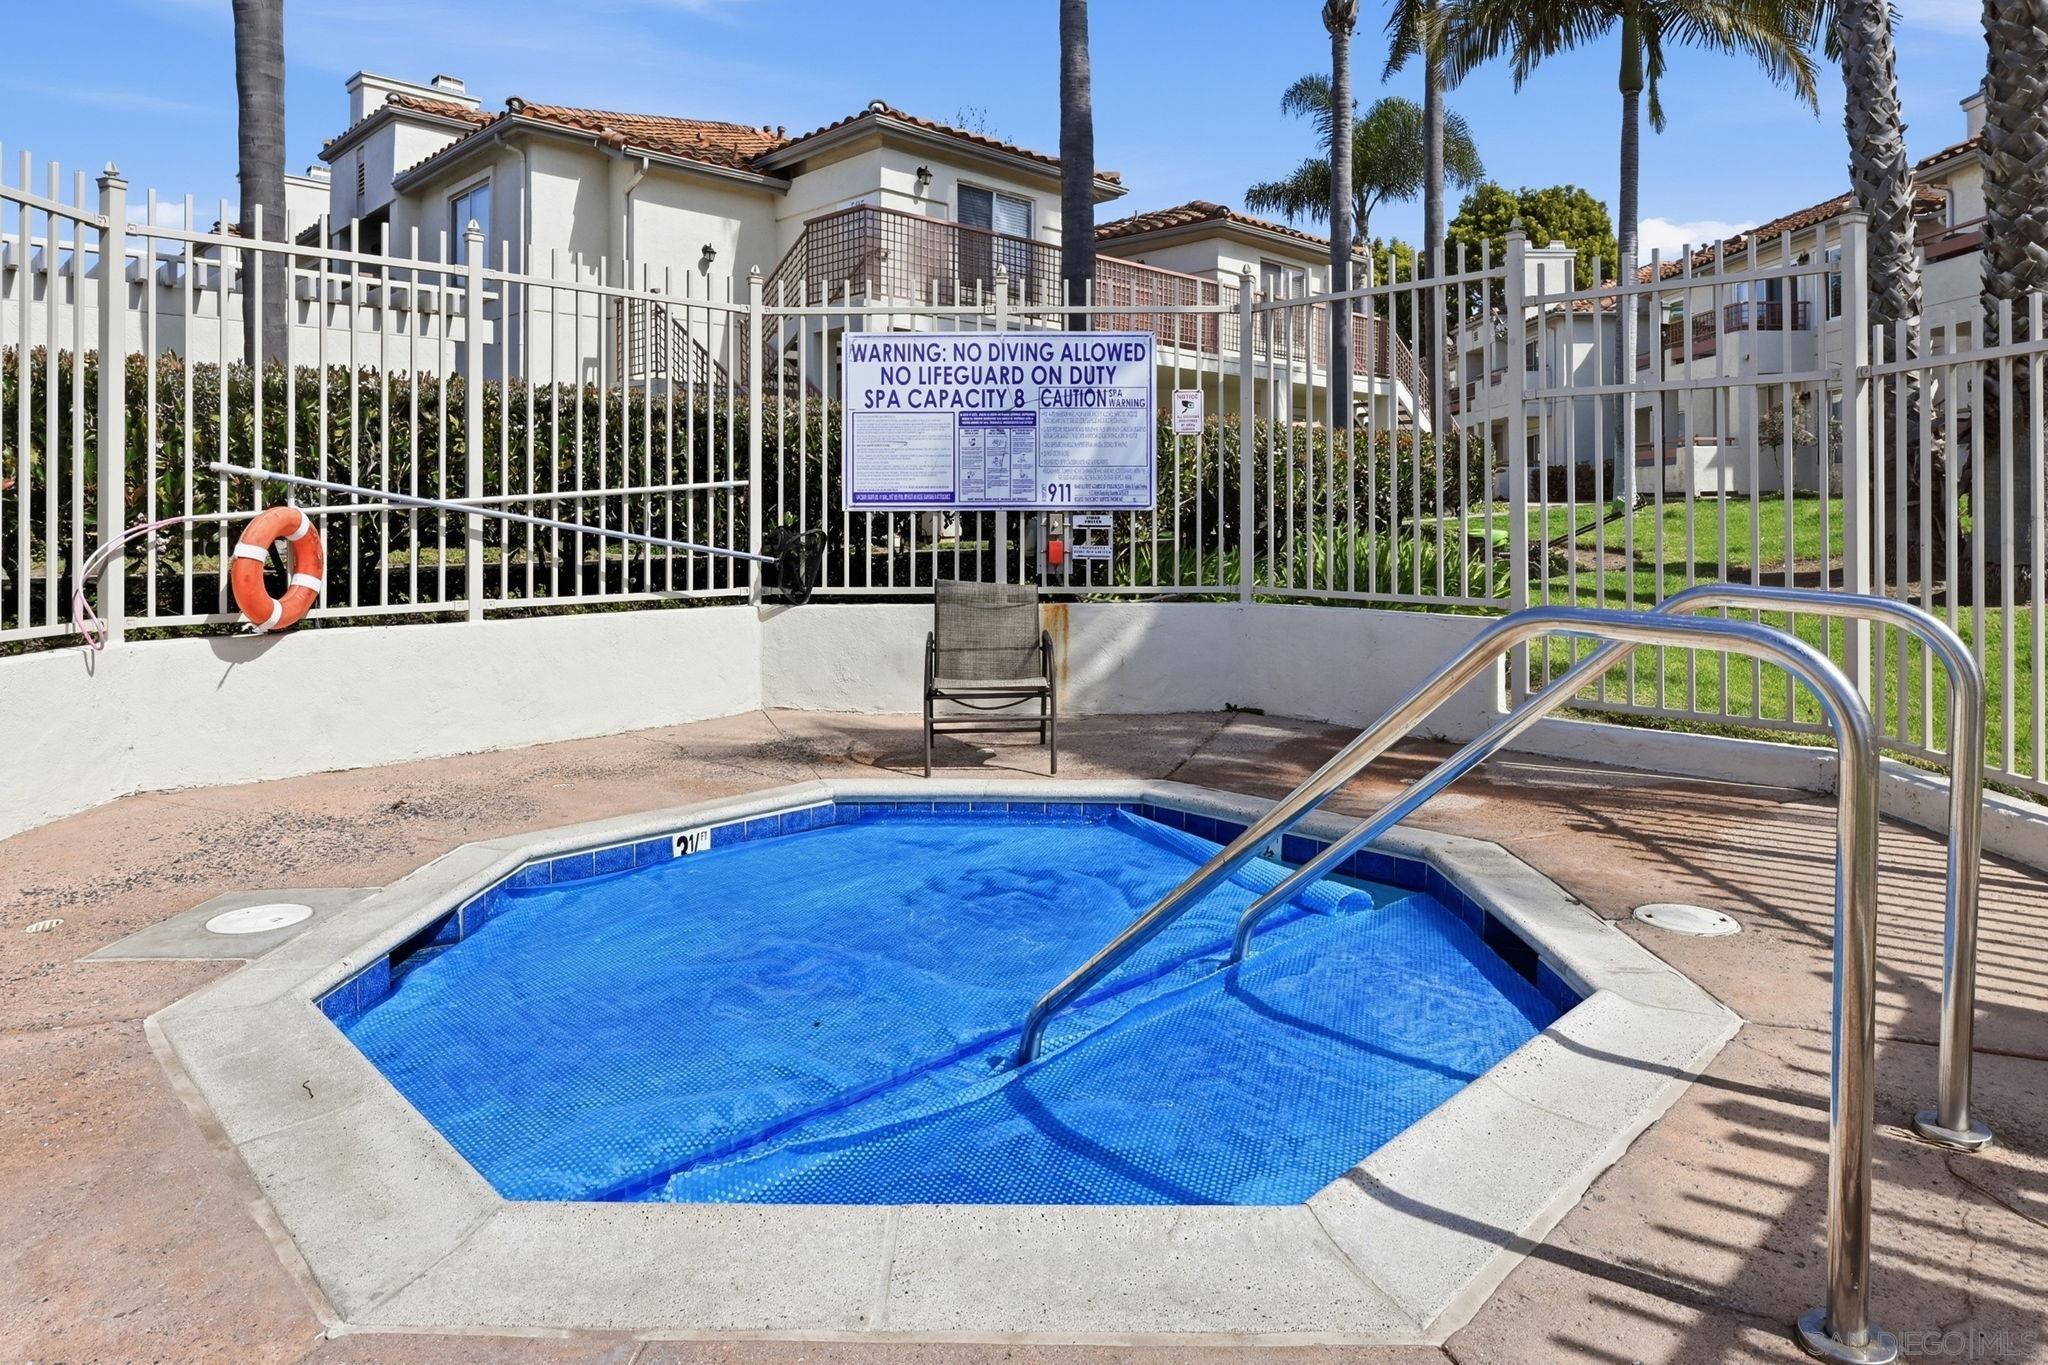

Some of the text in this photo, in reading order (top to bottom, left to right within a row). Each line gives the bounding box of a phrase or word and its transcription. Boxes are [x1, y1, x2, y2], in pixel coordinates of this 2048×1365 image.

[851, 343, 1146, 362] WARNING: NO DIVING ALLOWED
[881, 366, 1117, 385] NO LIFEGUARD ON DUTY
[864, 388, 1025, 409] SPA CAPACITY 8
[1041, 388, 1107, 408] CAUTION
[1108, 389, 1123, 398] SPA
[1108, 398, 1146, 408] WARNING
[1048, 483, 1072, 502] 911
